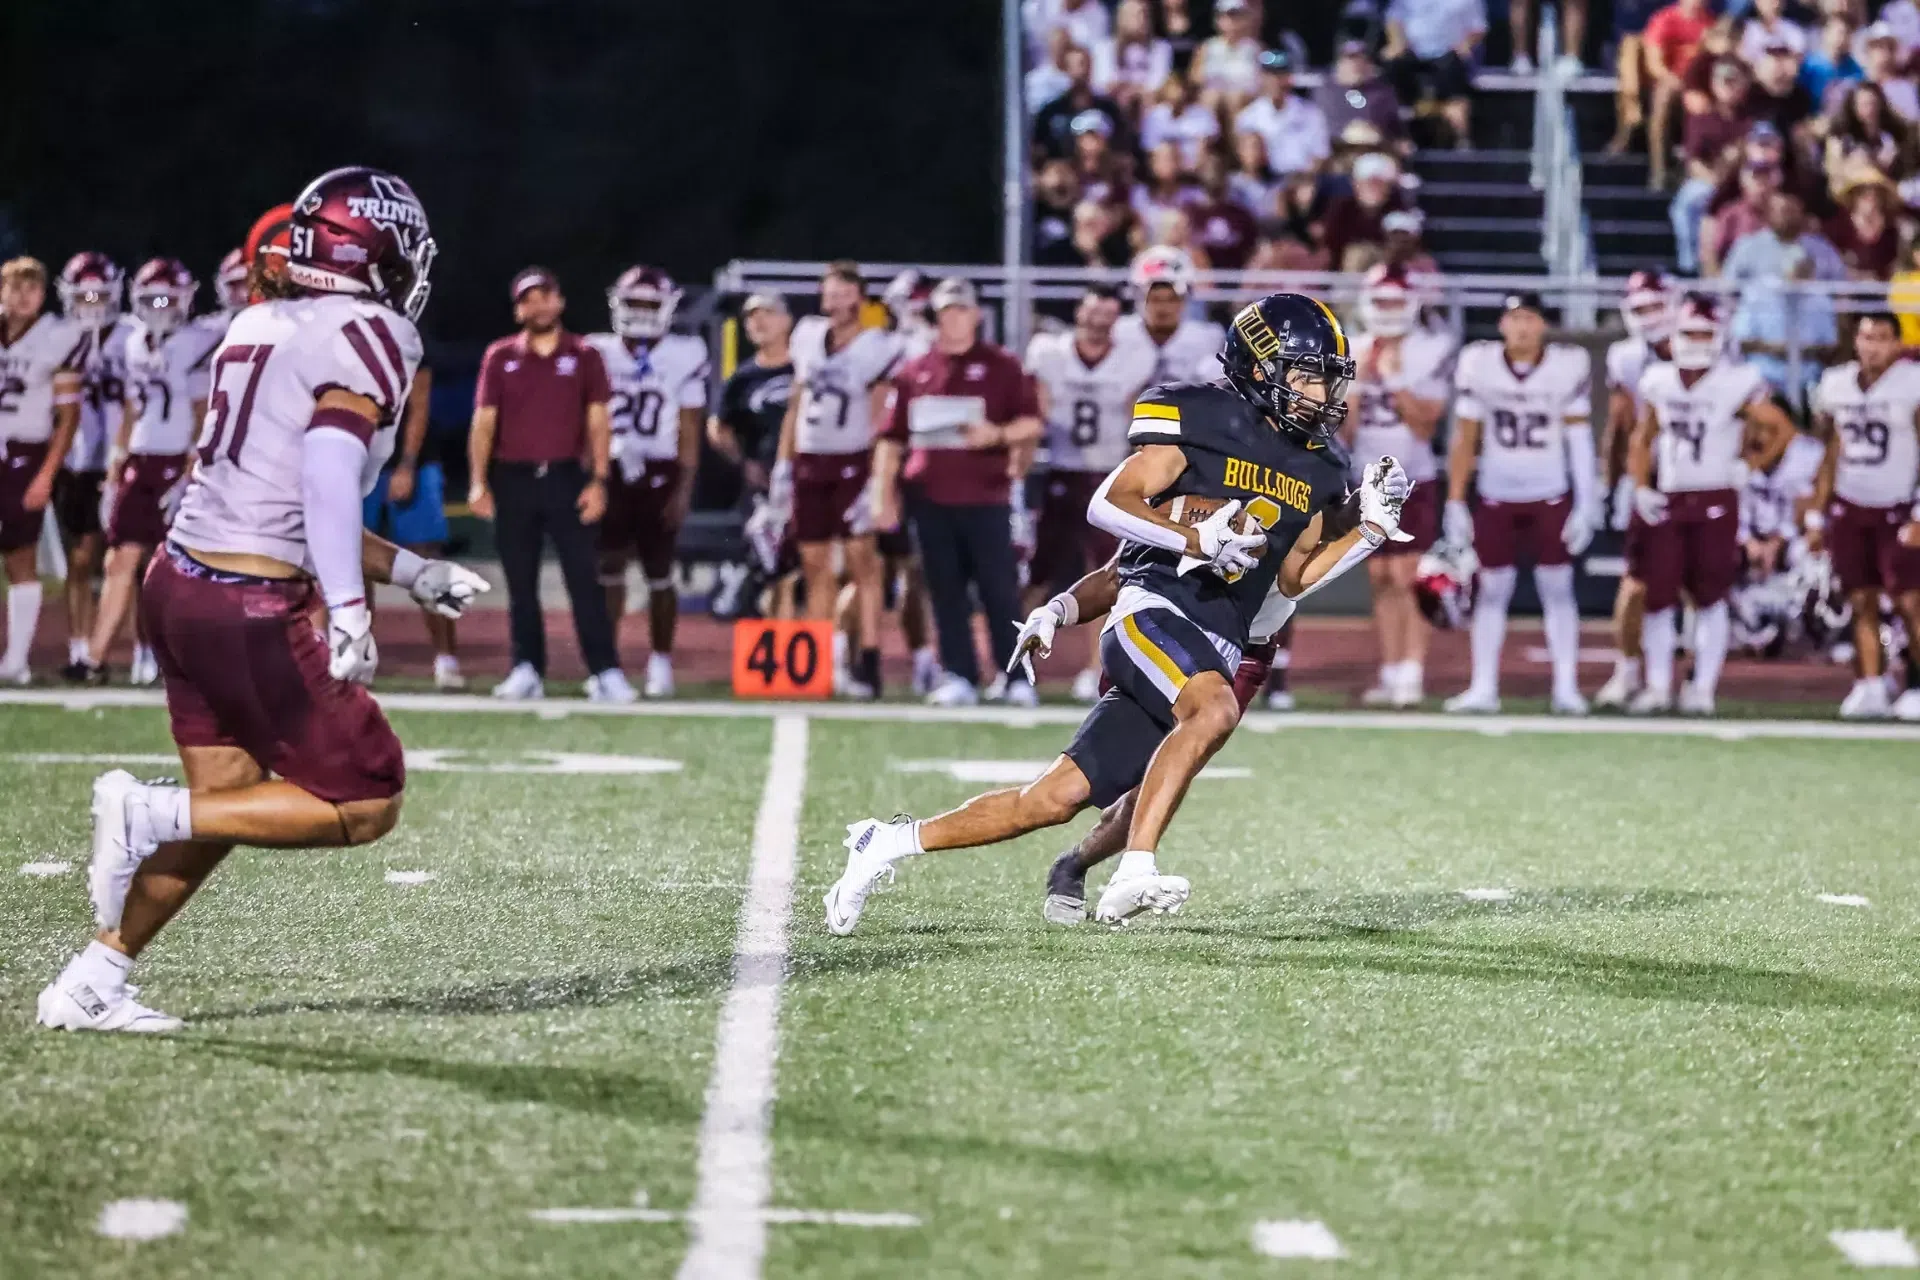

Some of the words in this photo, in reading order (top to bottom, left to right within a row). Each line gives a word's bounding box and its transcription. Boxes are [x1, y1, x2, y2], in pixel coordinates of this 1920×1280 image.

[292, 226, 314, 258] 51
[1235, 303, 1280, 360] TLU
[198, 344, 275, 468] 51
[609, 390, 664, 435] 20
[1072, 400, 1098, 445] 8
[1492, 410, 1549, 449] 82
[1223, 457, 1312, 513] BULLDOGS
[748, 629, 817, 686] 40
